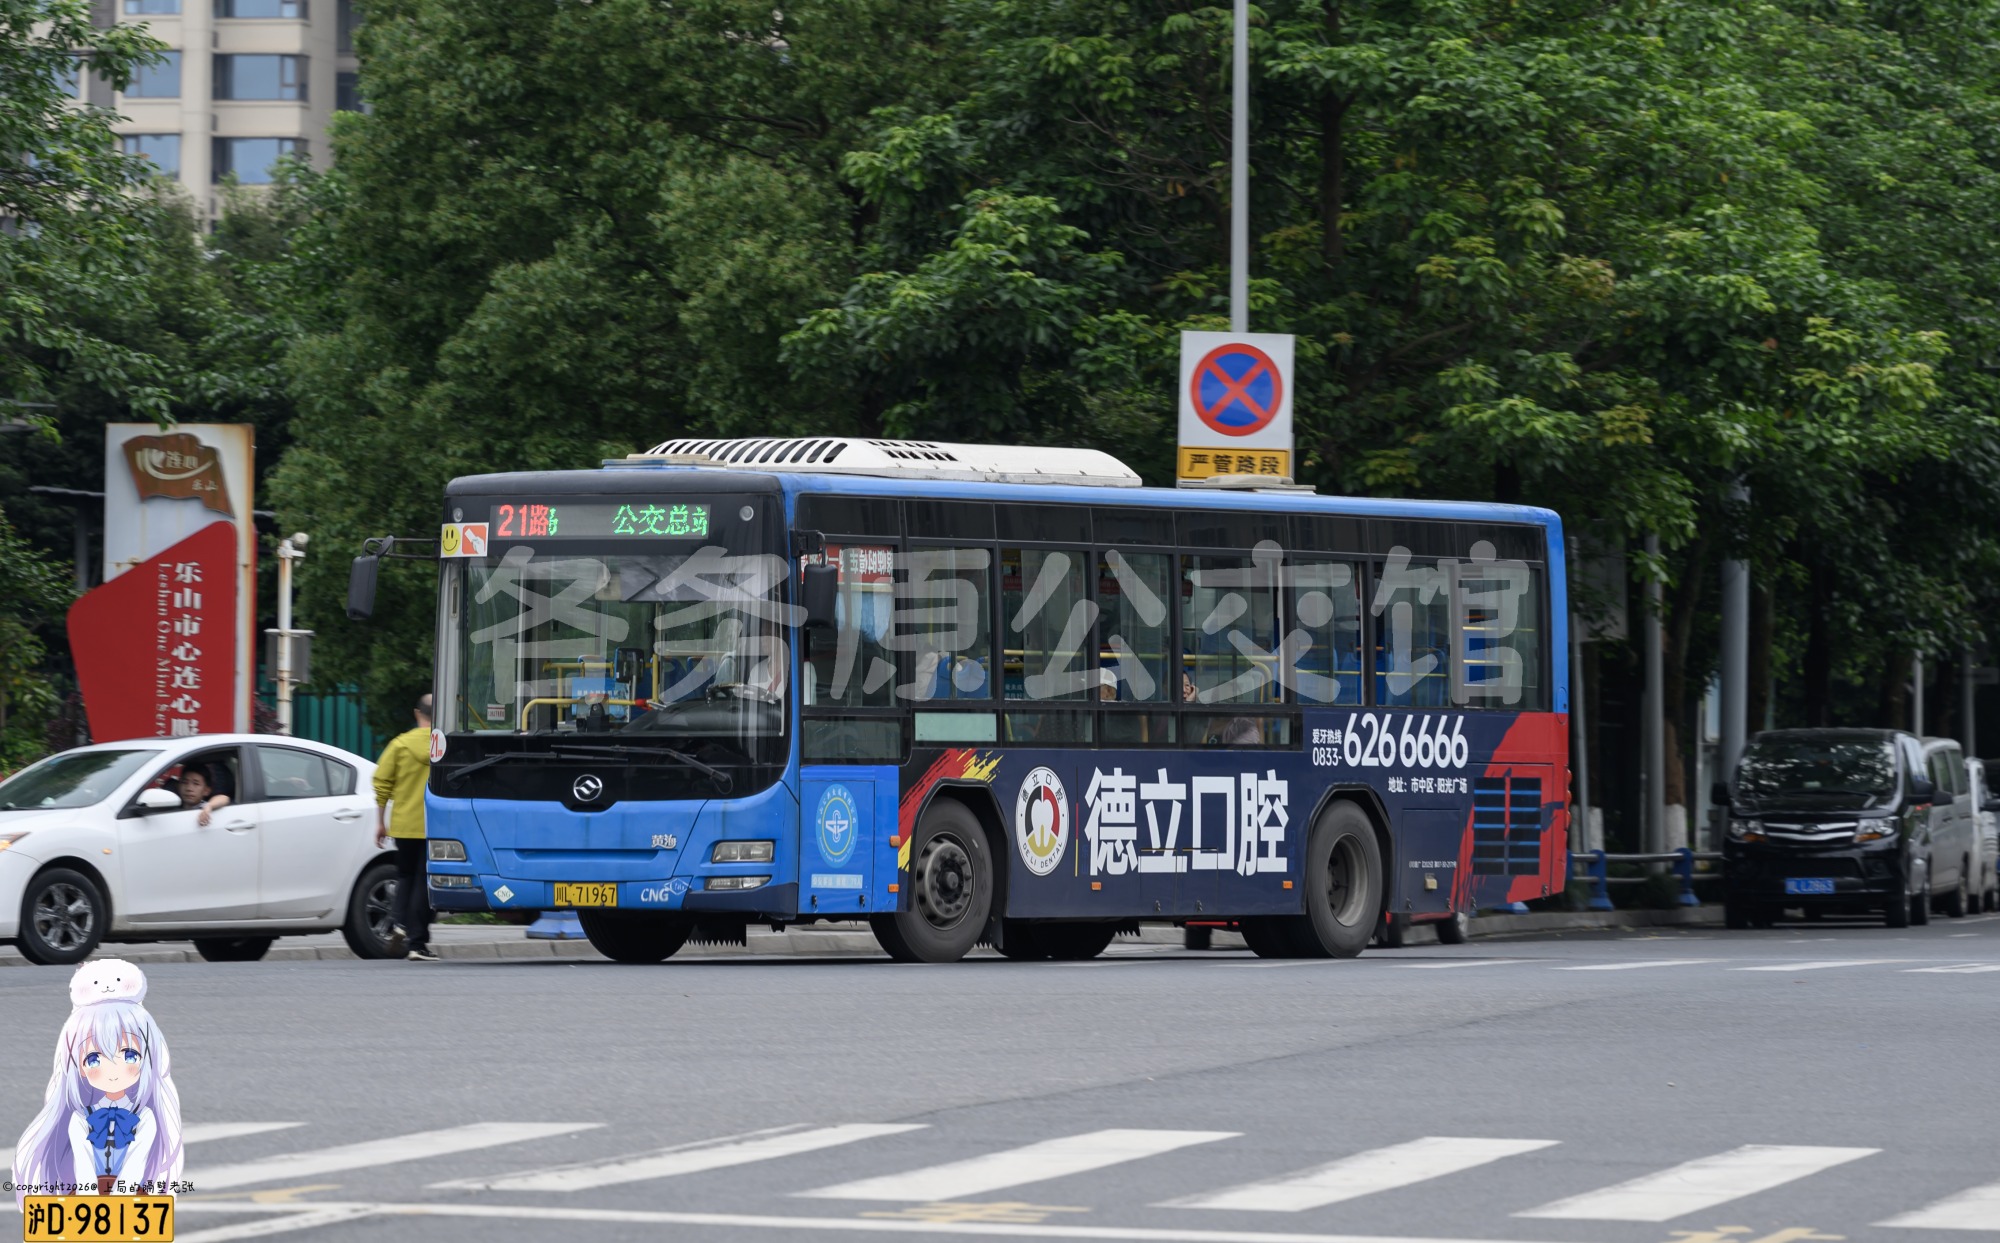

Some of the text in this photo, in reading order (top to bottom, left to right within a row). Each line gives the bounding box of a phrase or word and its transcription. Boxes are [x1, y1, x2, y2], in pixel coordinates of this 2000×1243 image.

[1187, 453, 1280, 475] 严管路段
[498, 504, 550, 536] 21路
[158, 563, 172, 615] Leshan
[157, 620, 172, 651] One
[156, 657, 171, 697] Mind
[1313, 729, 1342, 745] 爱牙热线
[1313, 747, 1342, 766] 0833-
[1084, 766, 1290, 878] 德立口腔
[1041, 842, 1063, 868] DENTAL
[640, 888, 669, 902] CNG
